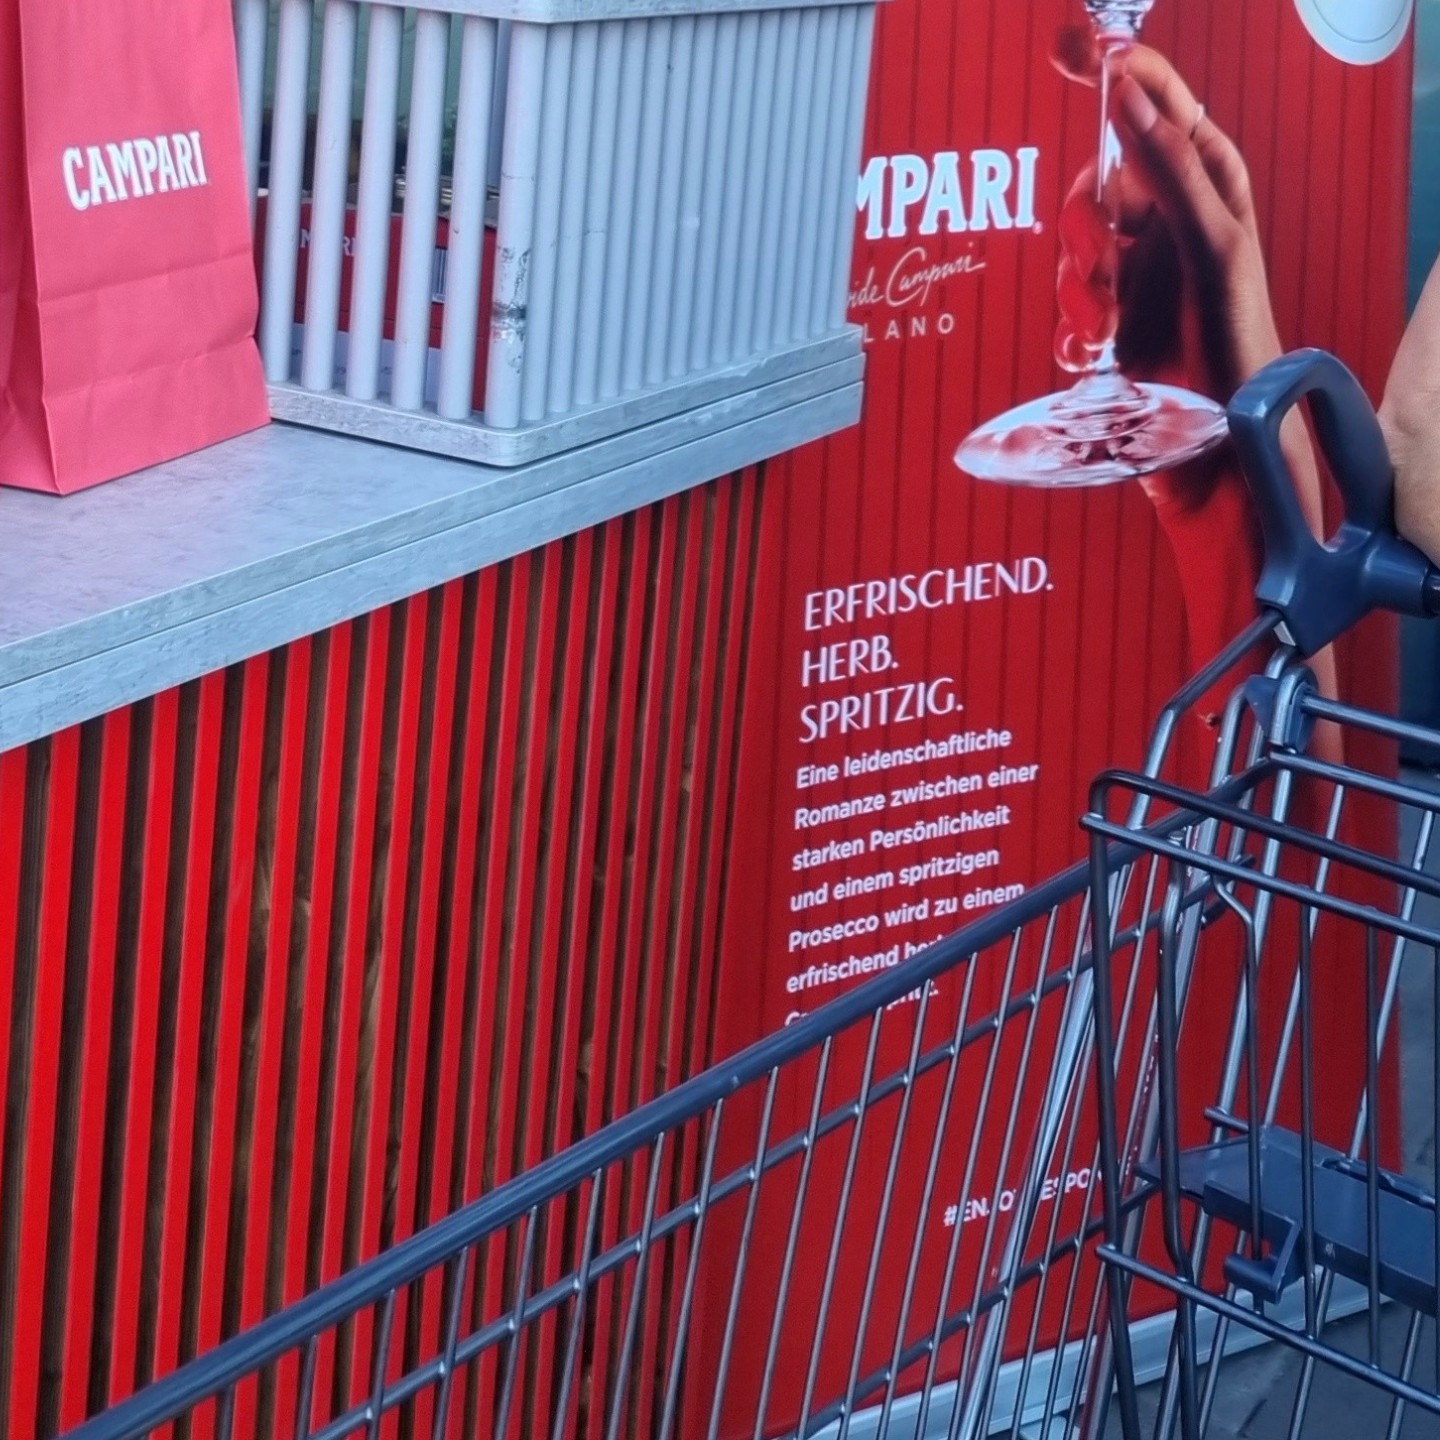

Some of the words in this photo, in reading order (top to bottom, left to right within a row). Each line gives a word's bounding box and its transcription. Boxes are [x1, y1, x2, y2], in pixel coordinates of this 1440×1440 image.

[62, 130, 209, 211] CAMPARI
[856, 146, 1041, 241] MPARI
[863, 312, 956, 344] LANO
[804, 557, 1055, 631] ERFRISCHEND.
[801, 634, 900, 688] HERB.
[798, 676, 964, 743] SPRITZIG.
[796, 764, 839, 790] Eine
[843, 728, 1012, 777] leidenschaftliche
[794, 793, 887, 831] Romanze
[890, 773, 983, 808] zwischen
[987, 763, 1039, 788] einer
[791, 837, 865, 872] starken
[869, 804, 1011, 852] Persönlichkeit
[789, 882, 829, 912] und
[832, 870, 894, 901] einem
[898, 848, 1000, 888] spritzigen
[788, 914, 880, 953] Prosecco
[884, 898, 929, 928] wird
[933, 896, 959, 917] zu
[962, 882, 1025, 911] einem
[786, 944, 900, 994] erfrischend
